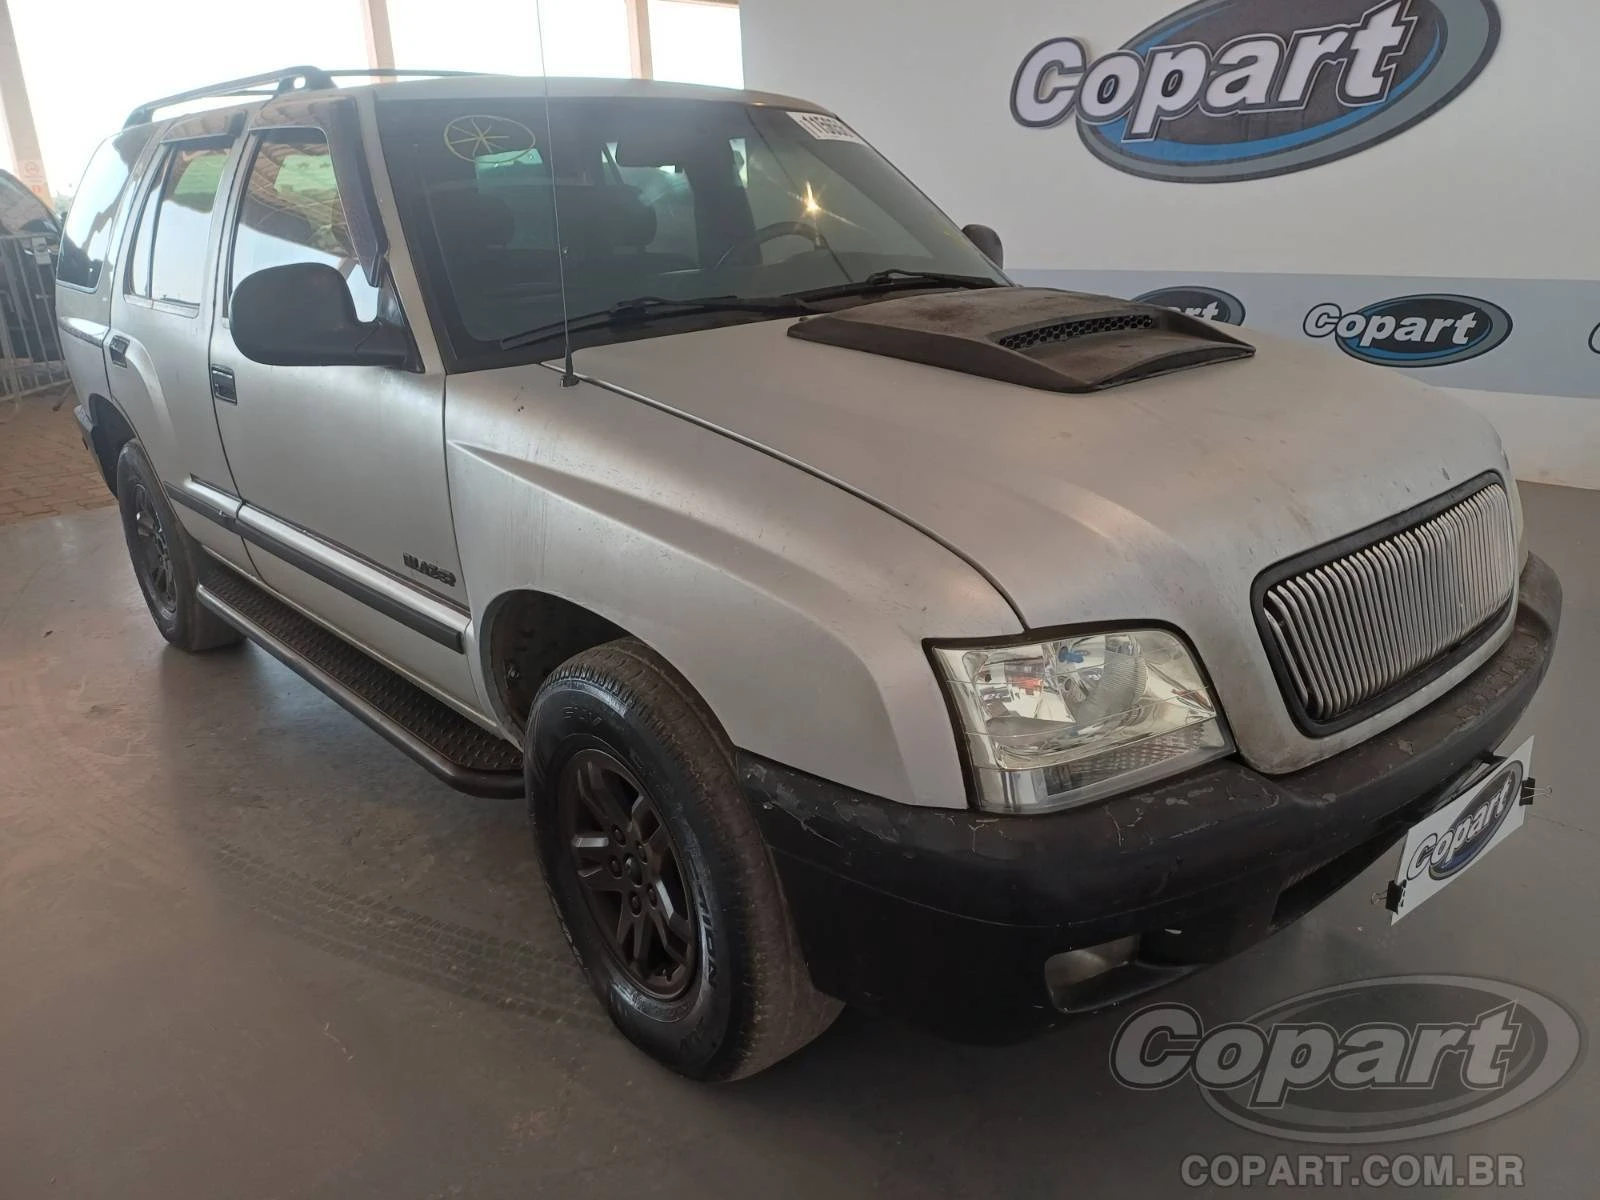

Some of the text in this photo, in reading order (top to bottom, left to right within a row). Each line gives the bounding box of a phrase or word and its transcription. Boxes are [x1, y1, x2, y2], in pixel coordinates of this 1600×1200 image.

[1011, 0, 1418, 142] Copart
[1304, 303, 1477, 347] Copart
[1407, 769, 1513, 880] Copart
